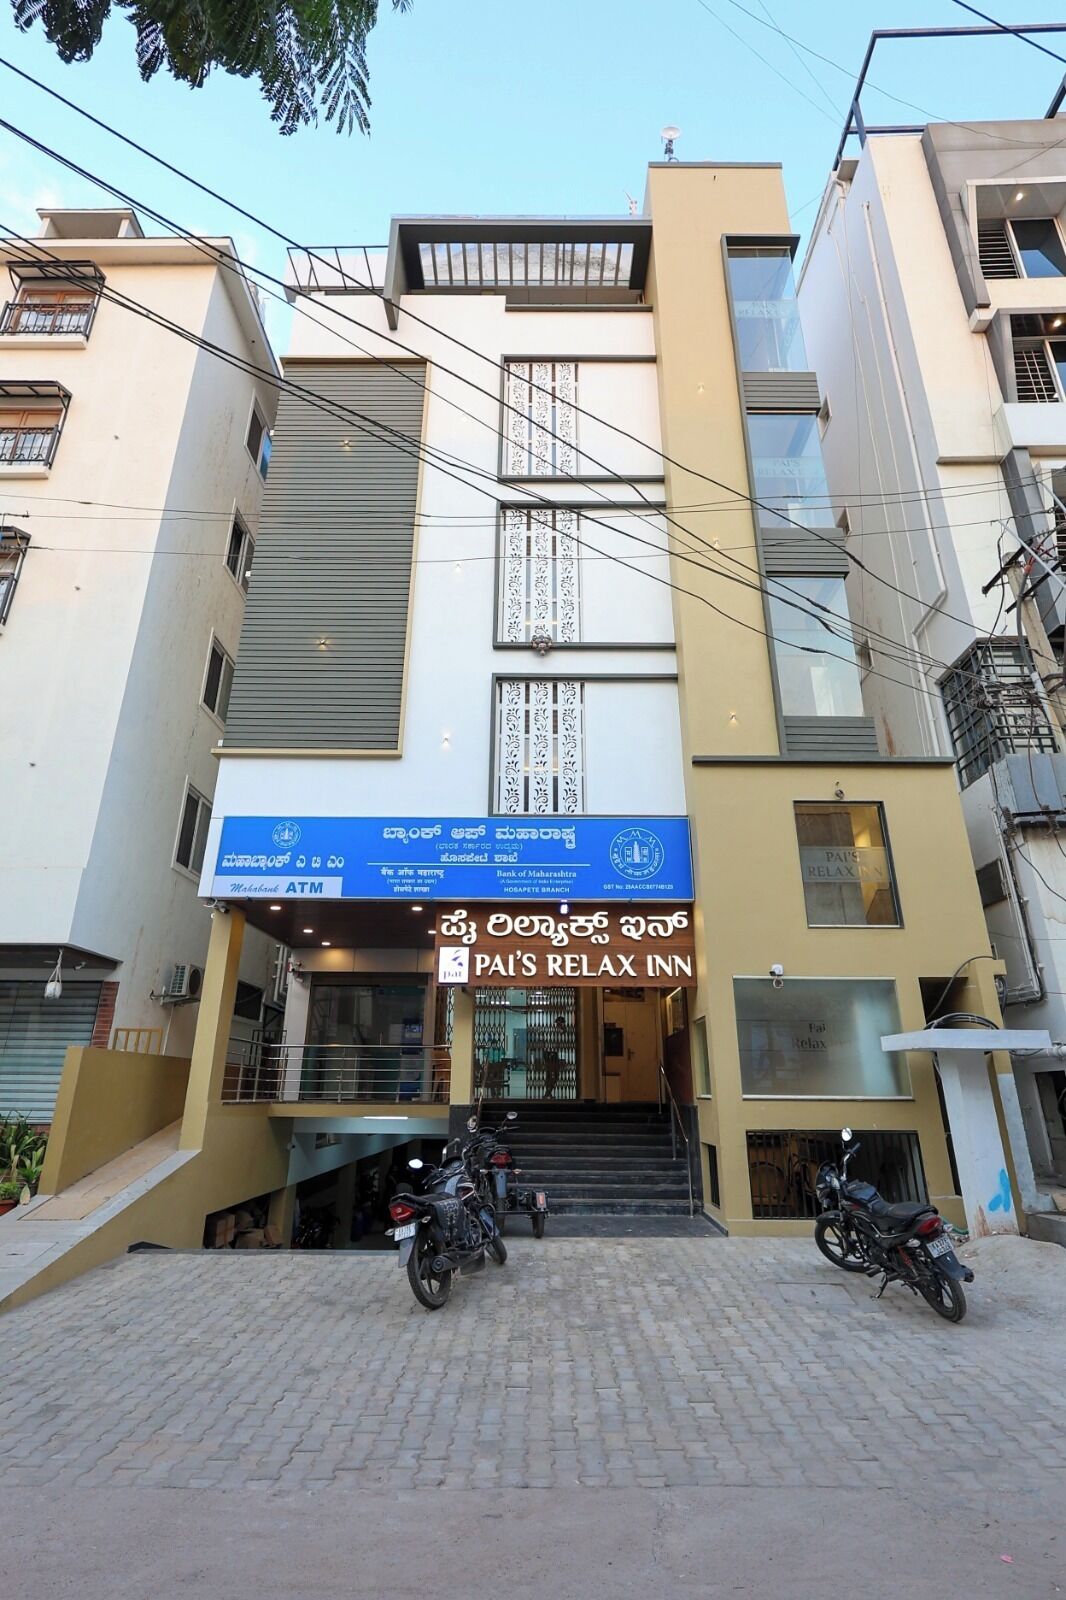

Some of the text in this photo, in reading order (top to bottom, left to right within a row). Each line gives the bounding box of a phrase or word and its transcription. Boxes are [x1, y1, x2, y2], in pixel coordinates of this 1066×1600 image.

[382, 824, 441, 844] ಬ್ಯಾಂಕ್
[495, 825, 577, 849] ಮಹಾರಾಷ್ಟ್ರ
[221, 851, 292, 871] ಮಹಾಬ್ಯಾಂಕ್
[825, 851, 860, 863] PAI'S
[496, 869, 577, 878] Bank of Maharashtra
[808, 865, 855, 877] RELAX
[230, 882, 324, 893] Mahabank ATM
[440, 908, 689, 947] ಪೈ ರಿಲ್ಯಾಕ್ಸ್ ಇನ್
[474, 950, 692, 977] PAI'S RELAX INN
[792, 1037, 827, 1049] Relax
